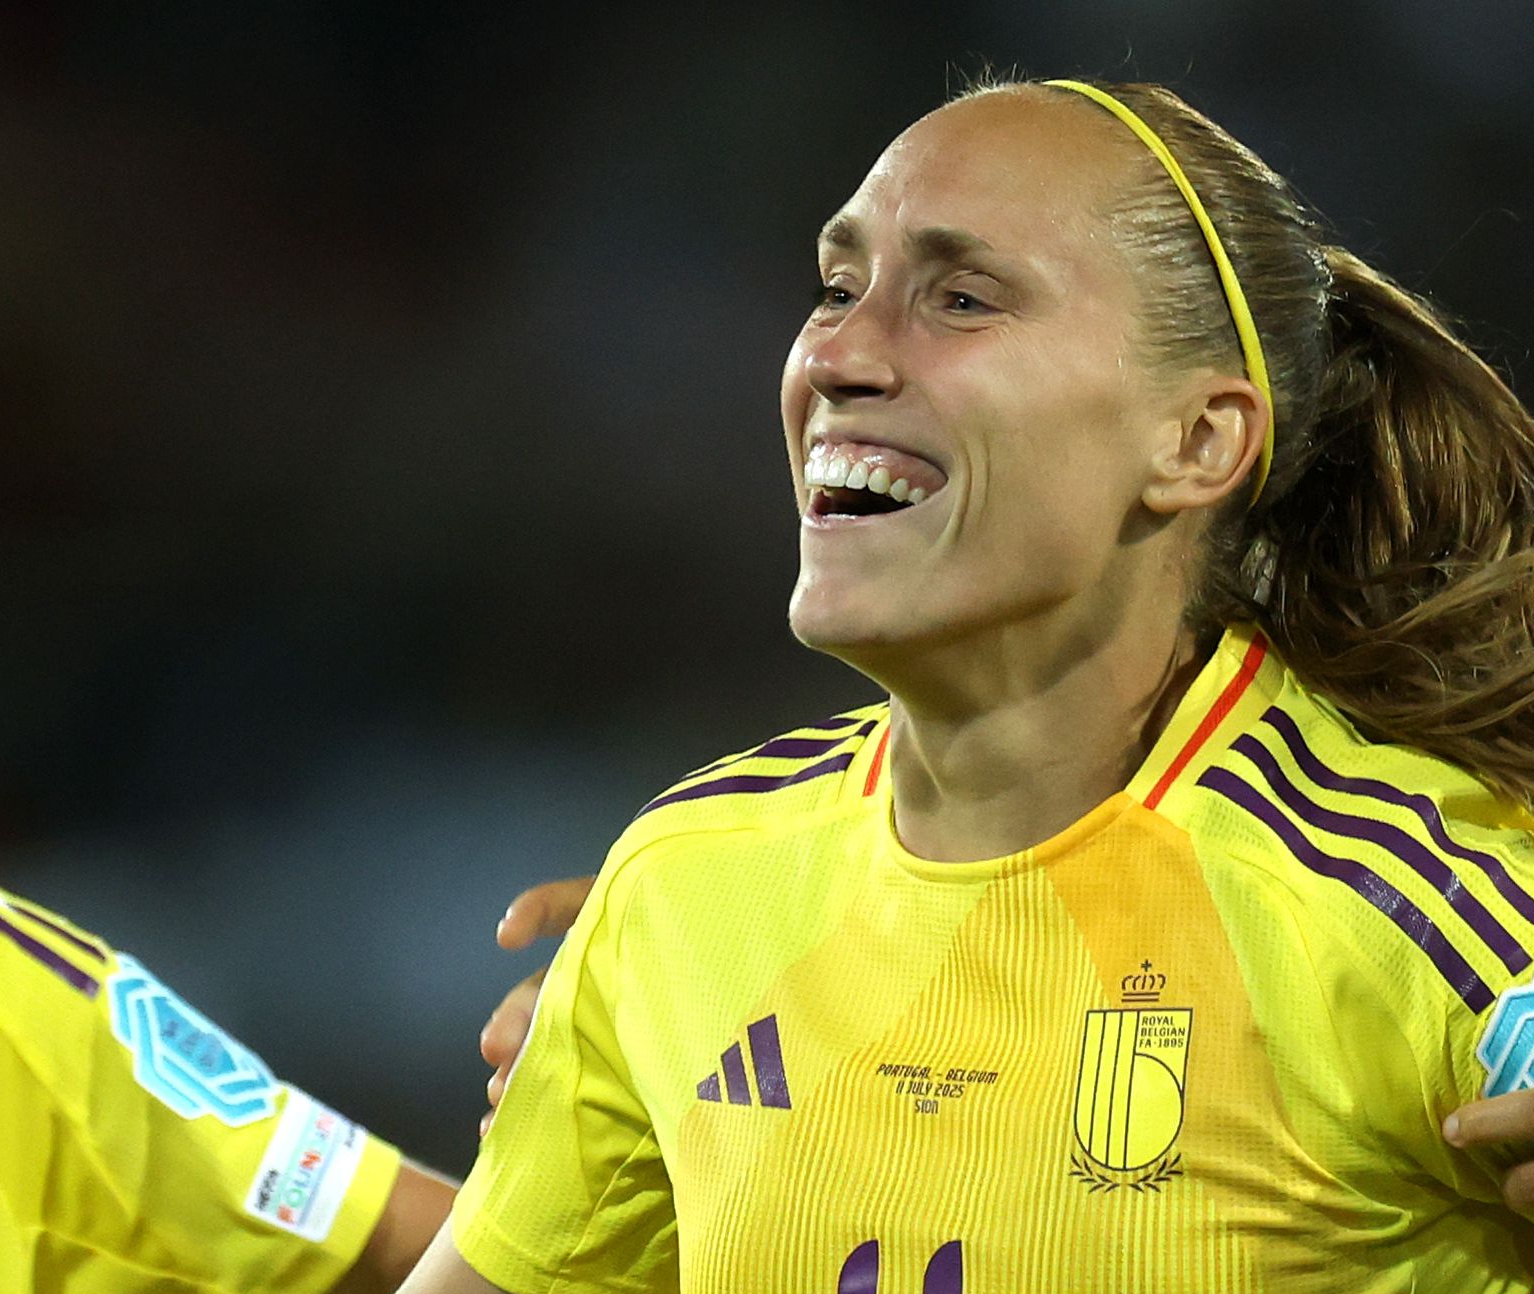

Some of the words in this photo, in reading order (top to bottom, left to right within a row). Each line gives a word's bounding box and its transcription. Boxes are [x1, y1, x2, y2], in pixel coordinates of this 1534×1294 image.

[1141, 1016, 1174, 1026] ROYAL
[1140, 1027, 1186, 1037] BELGIAN
[876, 1063, 932, 1080] PORTUGAL
[946, 1068, 999, 1085] BELGIUM
[906, 1081, 933, 1096] JULY
[934, 1083, 965, 1099] 2025
